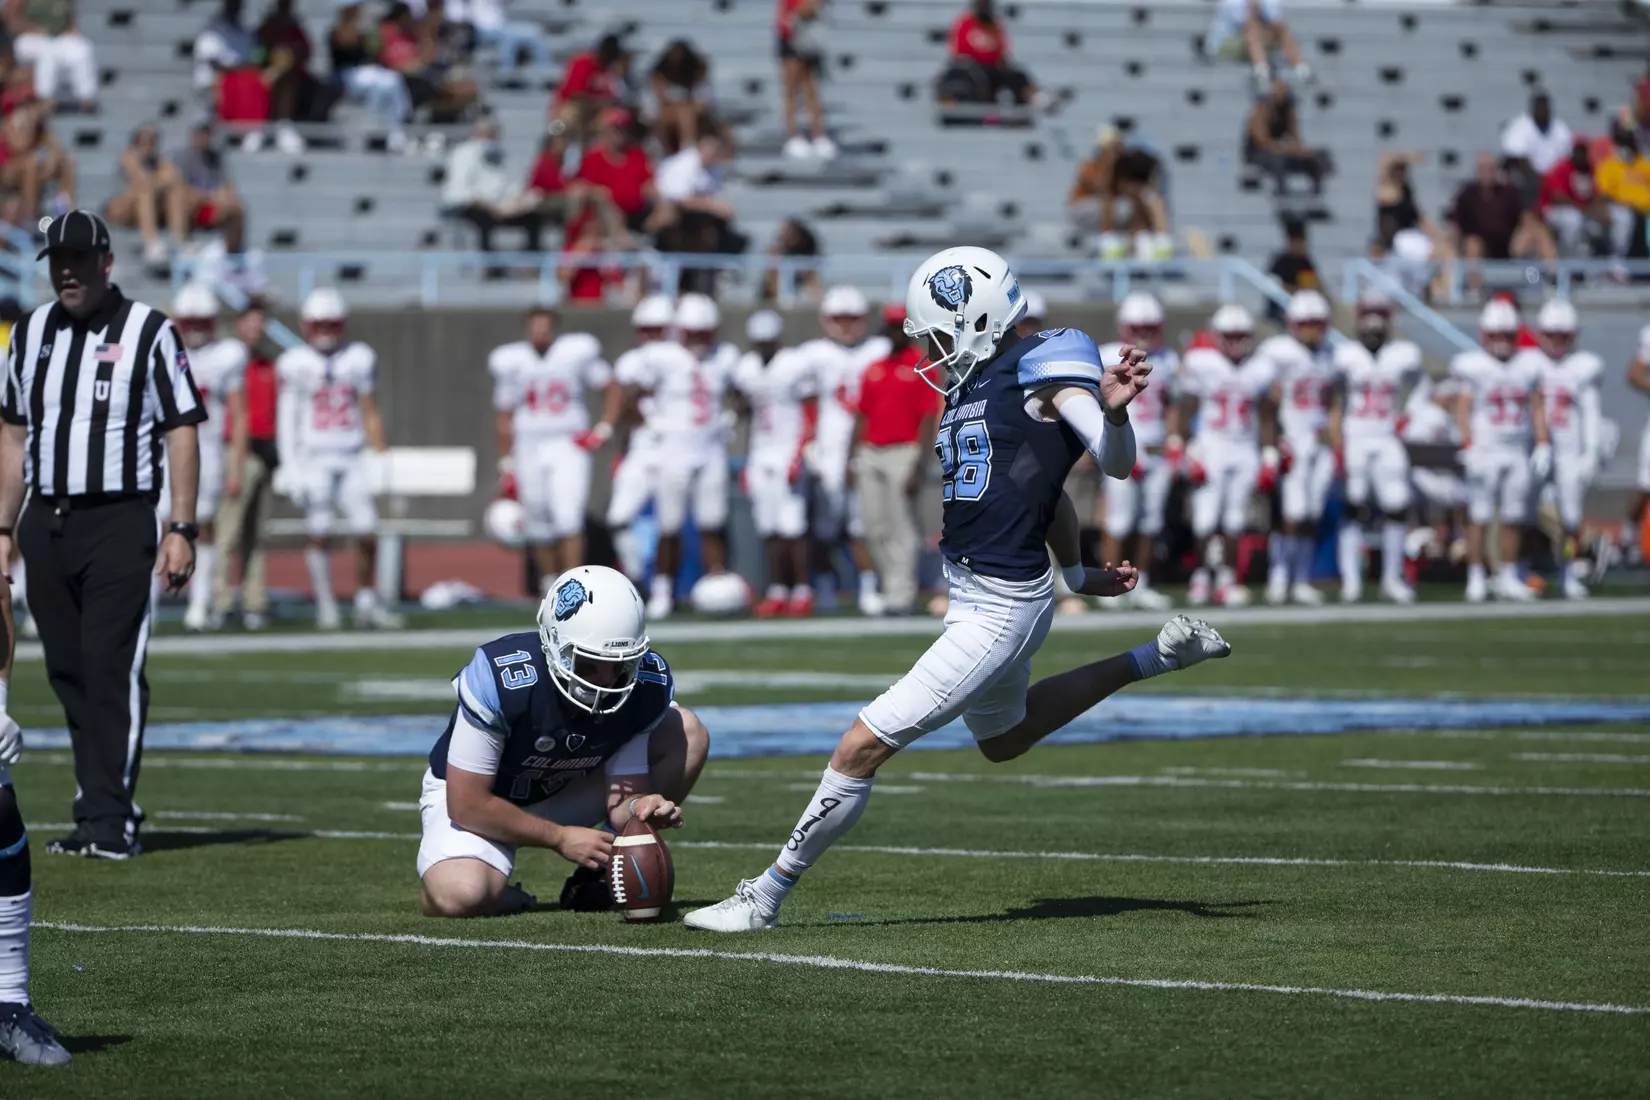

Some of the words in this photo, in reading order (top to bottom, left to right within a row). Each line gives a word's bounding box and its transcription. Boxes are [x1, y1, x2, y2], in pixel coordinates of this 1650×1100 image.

[95, 380, 111, 401] U
[940, 399, 988, 426] COLUMBIA
[934, 419, 993, 501] 28
[961, 556, 970, 565] M
[494, 650, 539, 690] 13
[521, 755, 603, 769] COLUMBIA
